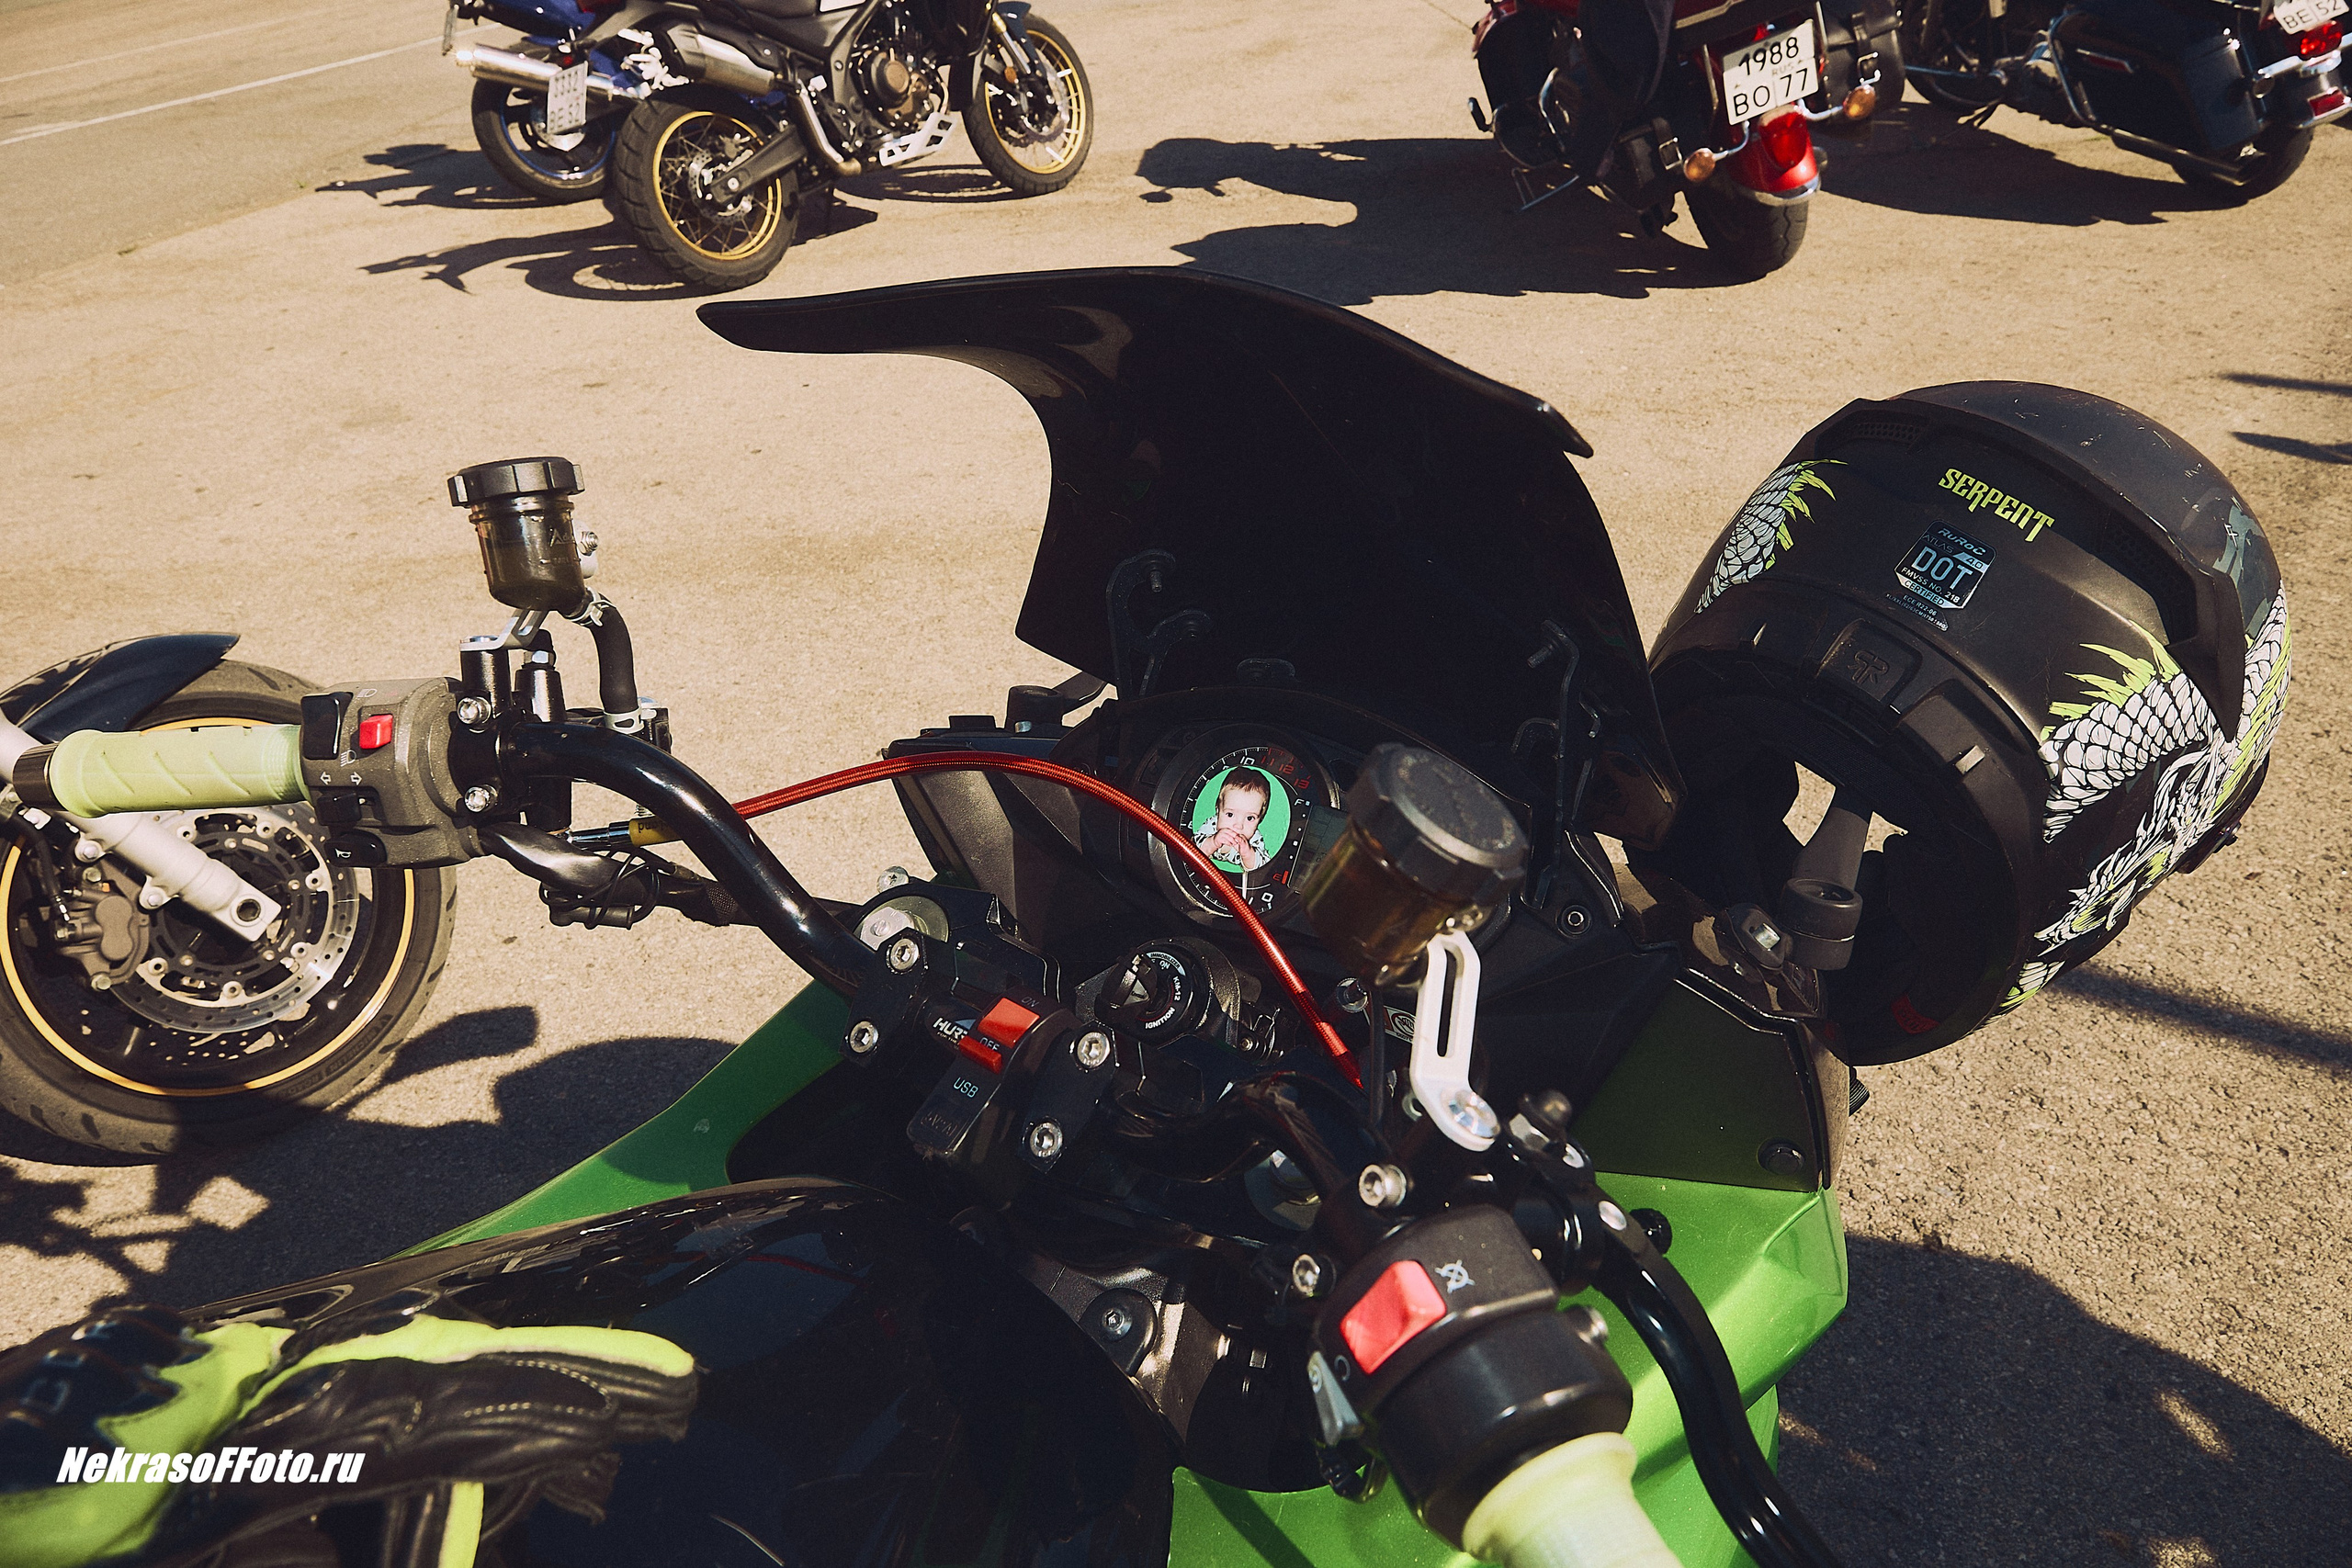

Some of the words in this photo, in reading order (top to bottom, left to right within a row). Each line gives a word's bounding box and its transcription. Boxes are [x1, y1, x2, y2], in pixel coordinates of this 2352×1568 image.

[2316, 0, 2341, 16] 52
[1738, 37, 1799, 75] 1988
[1733, 85, 1770, 117] BO
[1781, 67, 1808, 97] 77
[1938, 468, 2055, 542] SERPENT
[1922, 534, 1954, 554] ATLAS
[1965, 557, 1984, 570] 4.0
[1911, 546, 1973, 591] DOT
[1901, 567, 1929, 586] FMVSS
[1928, 582, 1943, 594] NO.
[1944, 591, 1962, 604] 218
[1904, 580, 1945, 606] CERTIFIED
[1903, 594, 1916, 604] ECE
[1239, 756, 1255, 765] 10
[1278, 764, 1295, 774] 12
[1294, 778, 1310, 789] 13
[1150, 953, 1181, 969] IMMOBILIZER
[1022, 996, 1040, 1008] ON
[1145, 1007, 1176, 1029] IGNITION
[953, 1077, 979, 1099] USB
